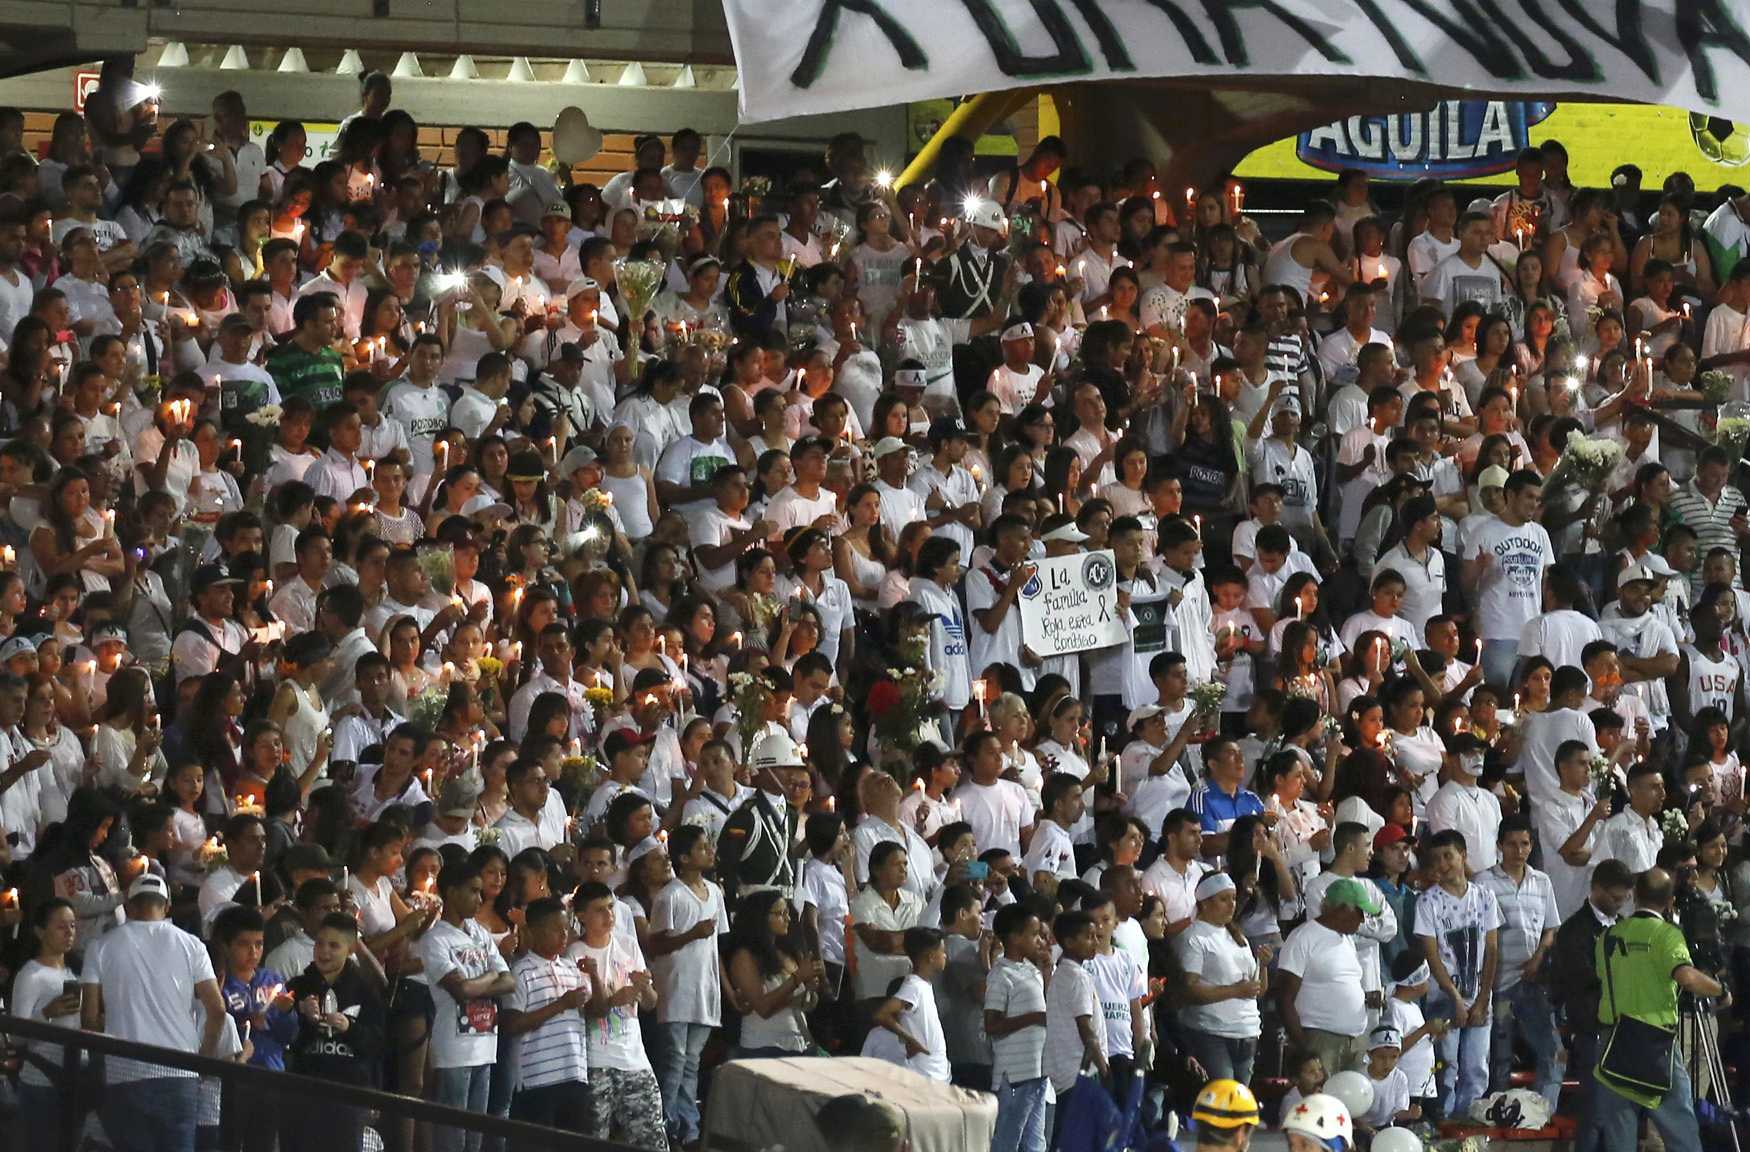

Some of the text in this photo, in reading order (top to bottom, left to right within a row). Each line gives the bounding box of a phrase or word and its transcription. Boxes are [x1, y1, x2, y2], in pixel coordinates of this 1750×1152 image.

[1494, 536, 1543, 557] OUTDOOR
[1051, 568, 1070, 590] La
[1699, 675, 1736, 694] USA
